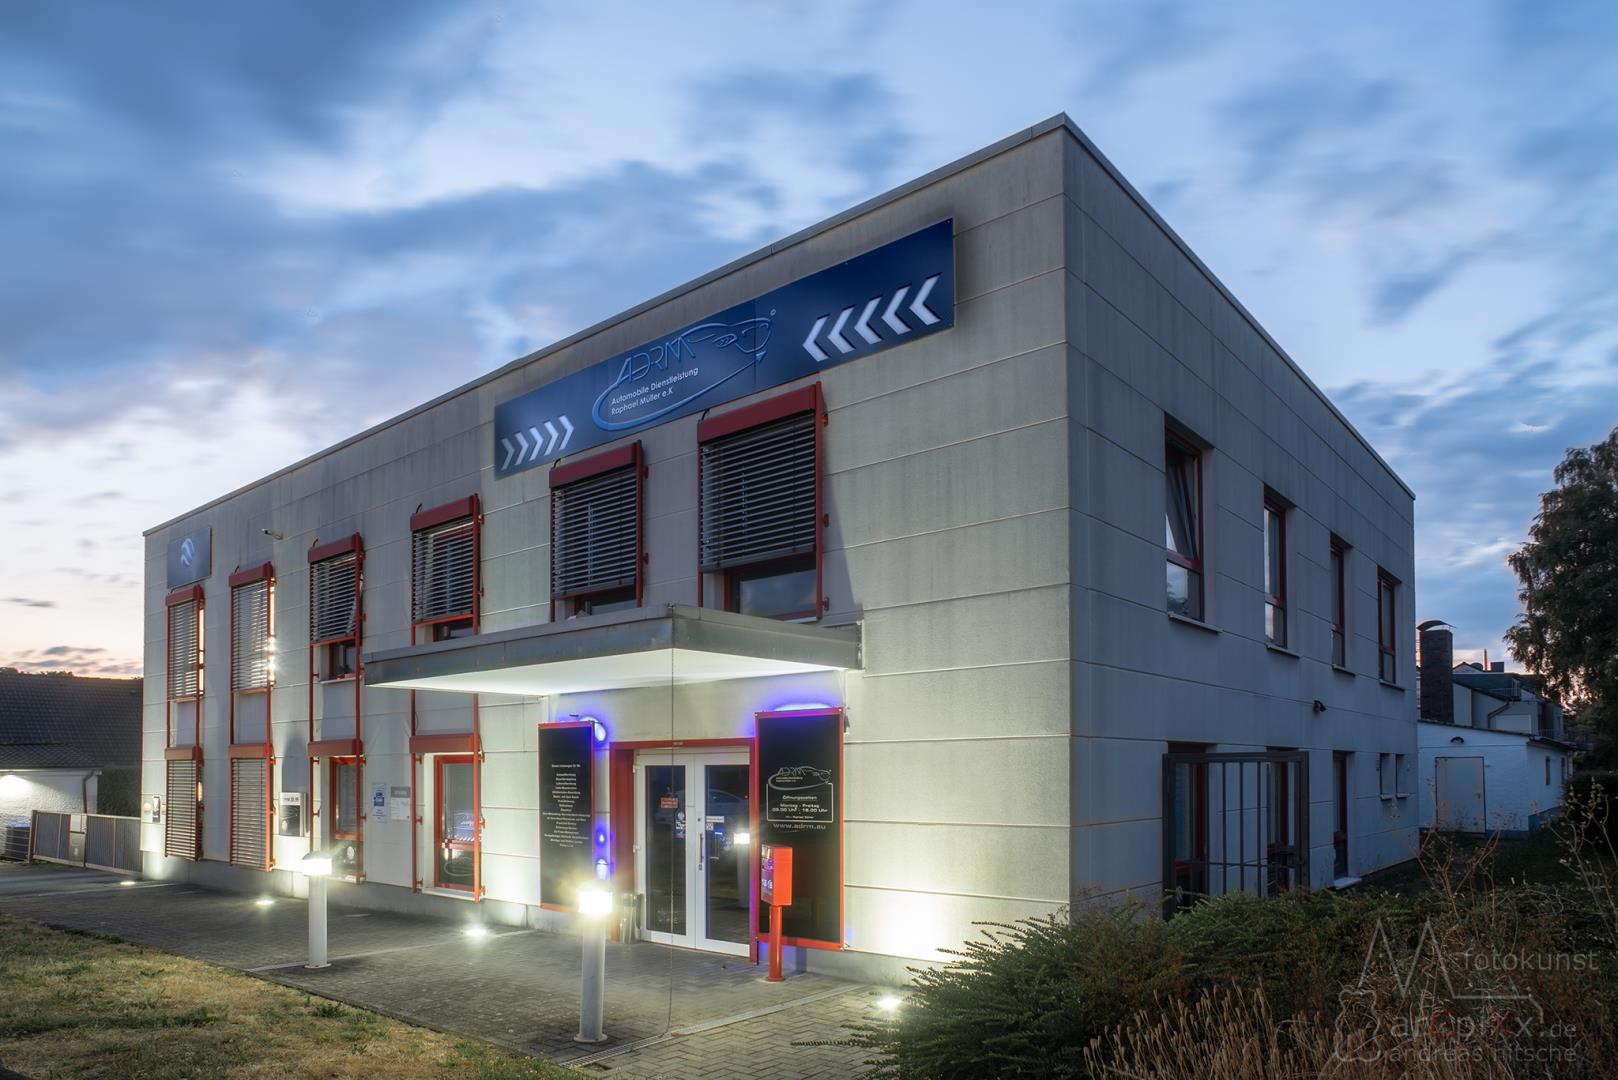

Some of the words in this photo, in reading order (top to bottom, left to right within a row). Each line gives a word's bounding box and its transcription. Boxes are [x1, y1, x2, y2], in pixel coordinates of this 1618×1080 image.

[612, 385, 649, 405] Automobile
[651, 367, 699, 391] Dienstleistung
[611, 400, 640, 416] Raphael
[640, 392, 661, 408] Müller
